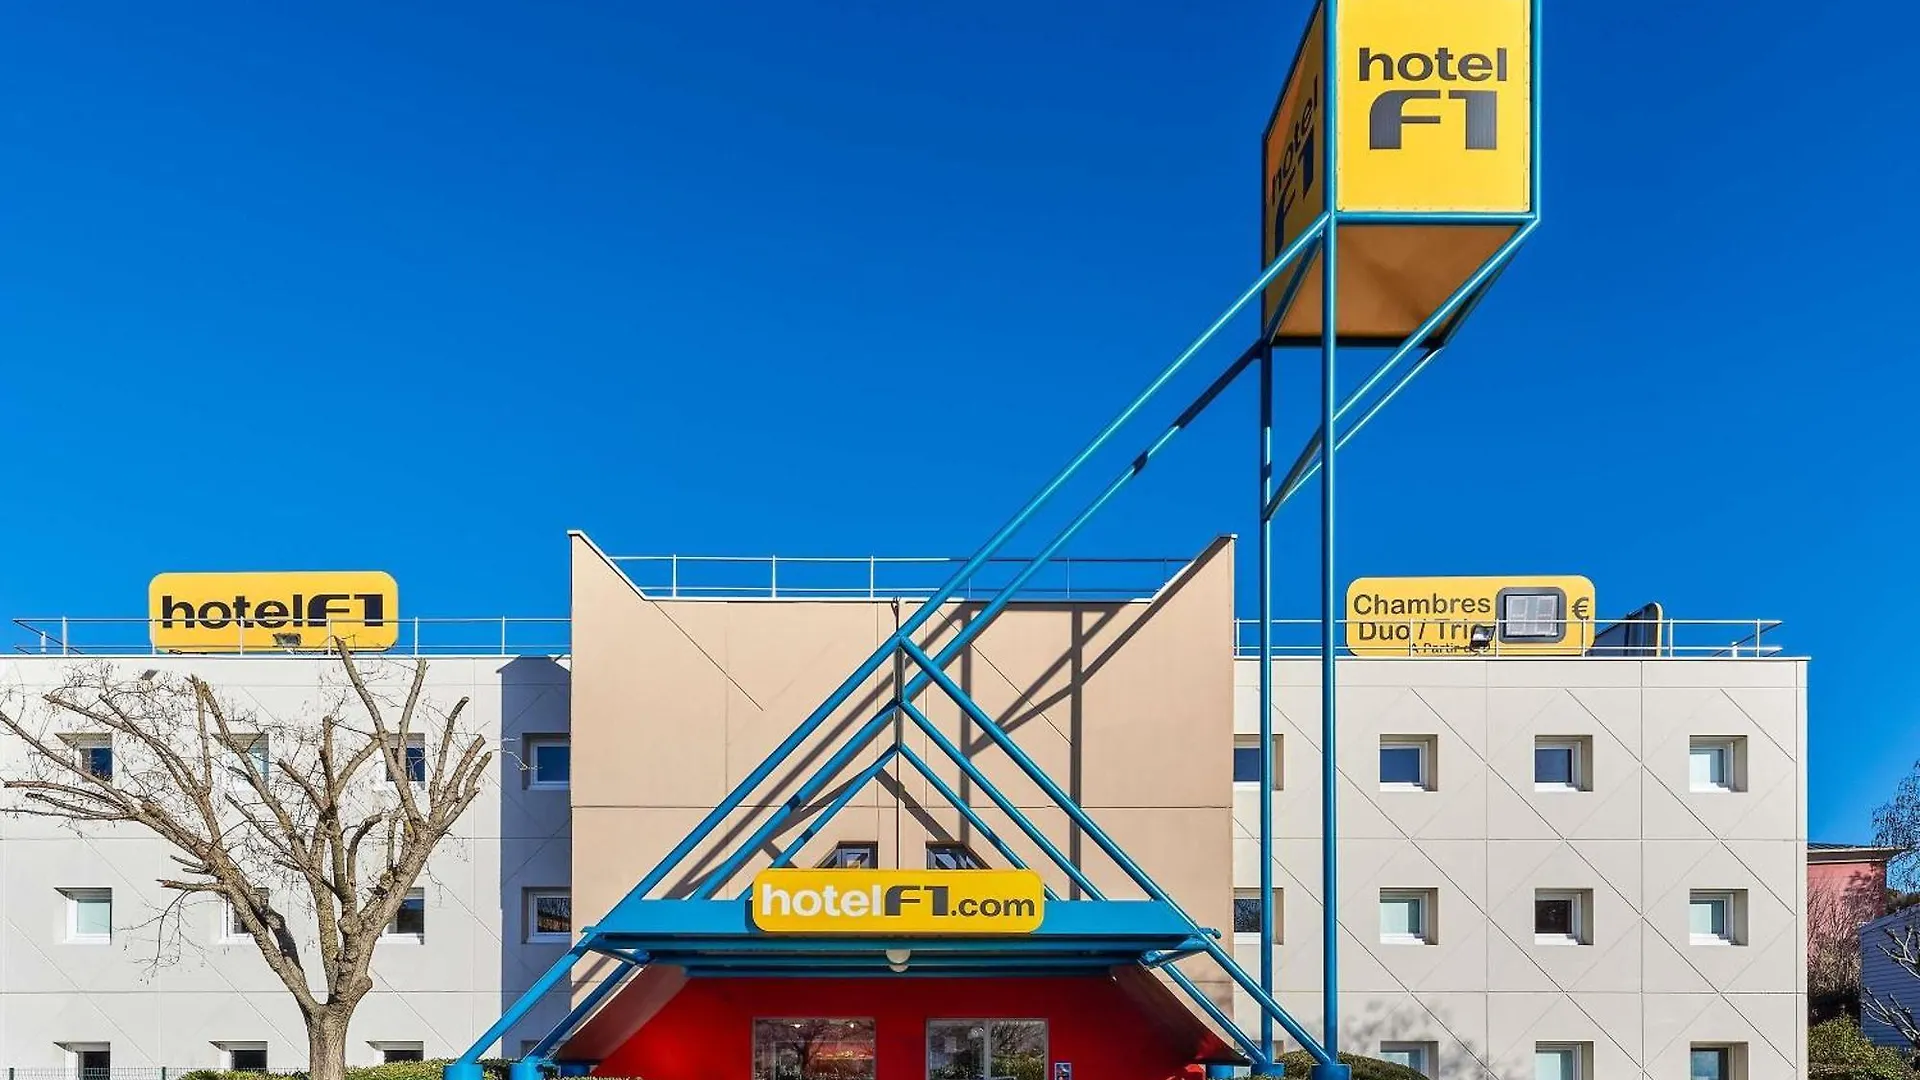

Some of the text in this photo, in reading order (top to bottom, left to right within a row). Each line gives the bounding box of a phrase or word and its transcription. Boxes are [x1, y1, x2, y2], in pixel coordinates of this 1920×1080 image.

[1358, 47, 1507, 82] hotel
[1369, 89, 1497, 150] F1
[1272, 74, 1319, 206] hotel
[162, 594, 383, 628] hotelF1
[1353, 592, 1491, 615] Chambres
[1358, 619, 1410, 640] Duo
[1437, 618, 1485, 640] Tri
[761, 884, 1036, 917] hotelF1.com
